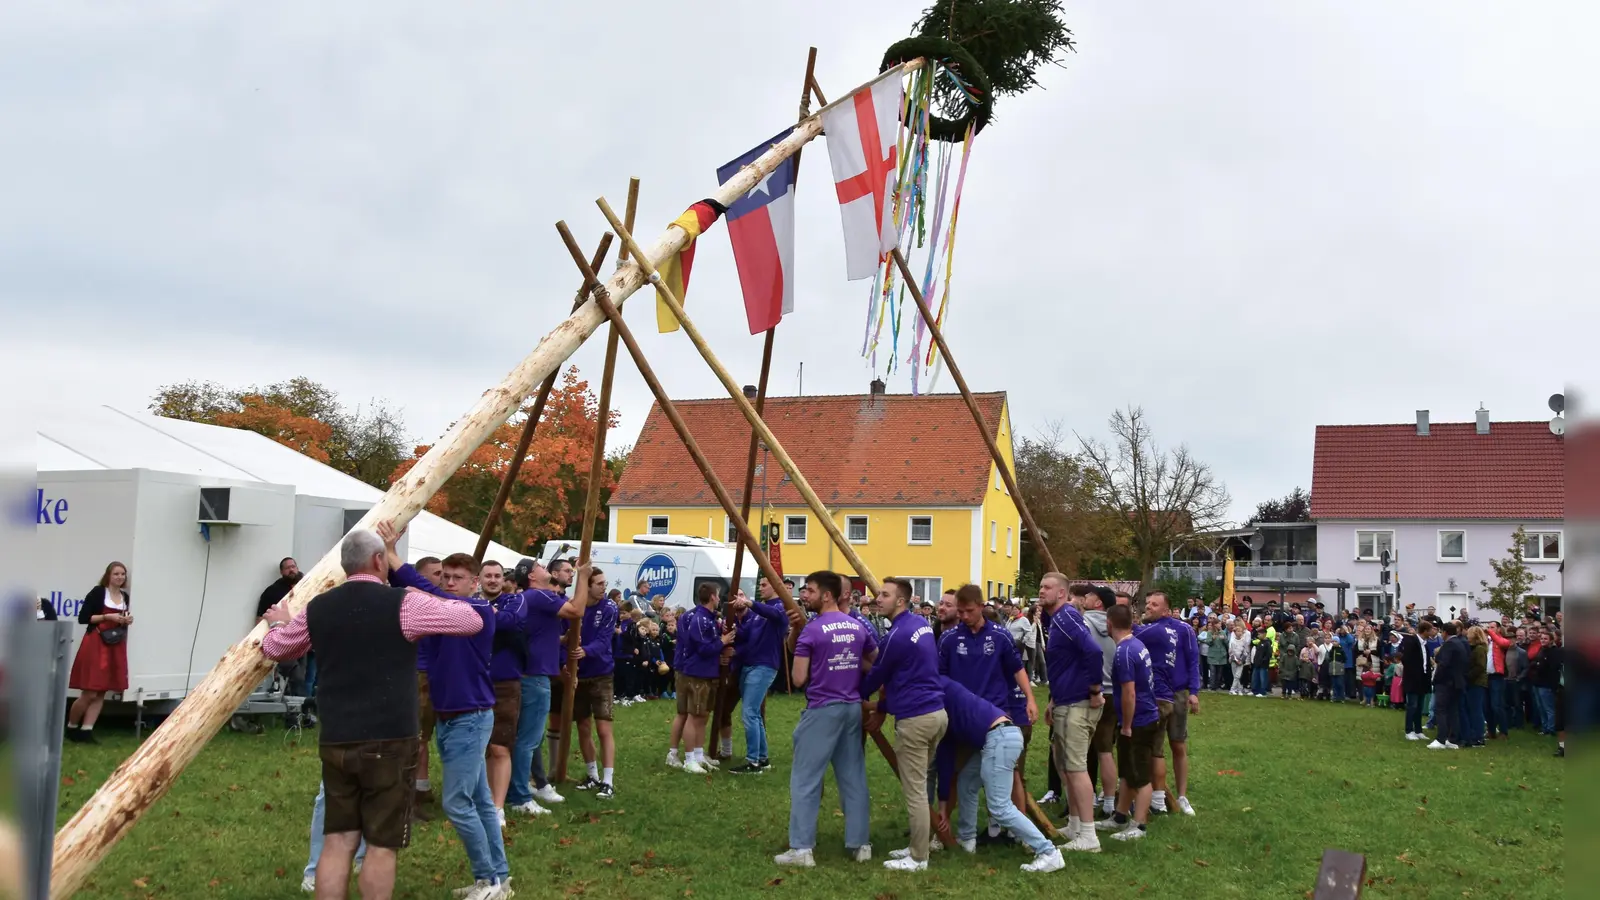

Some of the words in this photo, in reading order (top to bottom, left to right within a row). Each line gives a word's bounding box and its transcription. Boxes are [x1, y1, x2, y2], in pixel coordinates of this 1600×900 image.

[639, 566, 674, 581] Muhr
[822, 621, 859, 633] Auracher
[832, 634, 855, 643] Jungs
